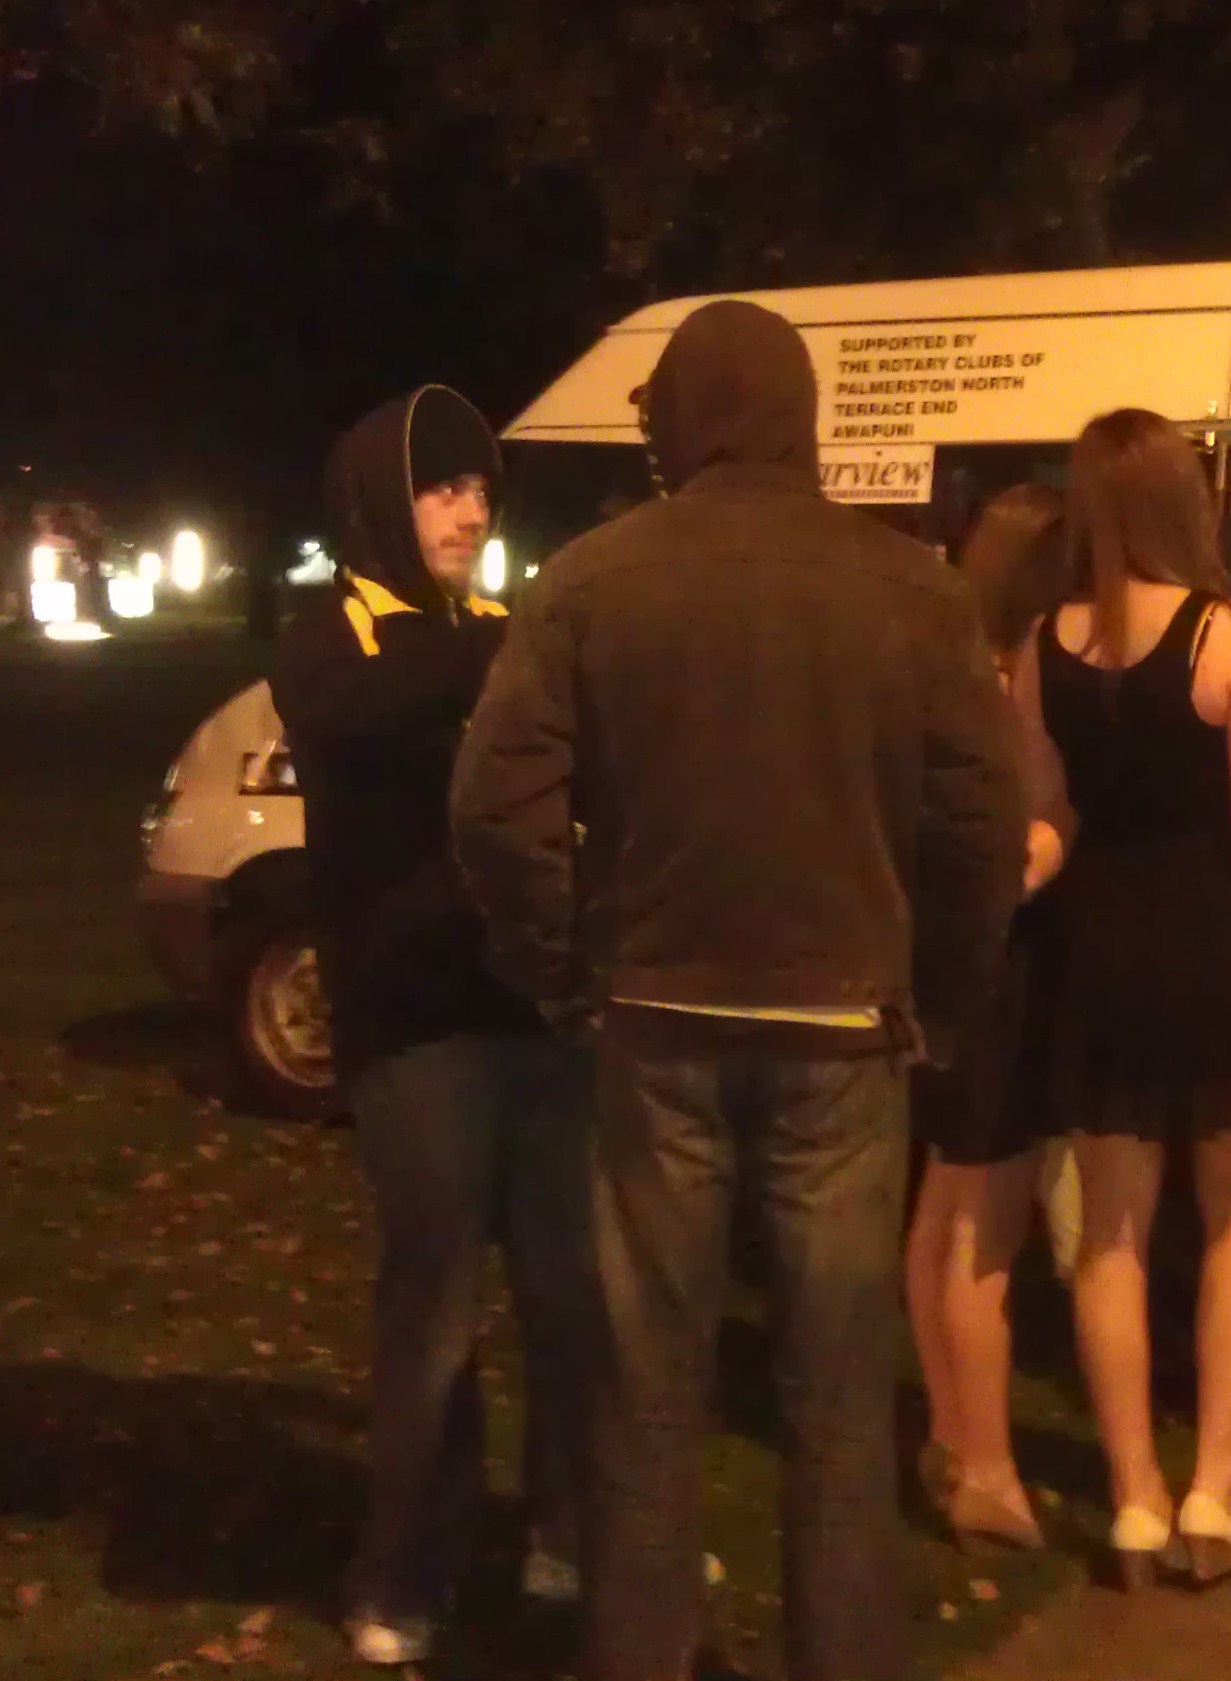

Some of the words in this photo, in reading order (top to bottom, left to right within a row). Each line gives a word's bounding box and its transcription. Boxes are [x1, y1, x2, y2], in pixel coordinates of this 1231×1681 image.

[839, 335, 947, 353] SUPPORTED
[953, 334, 977, 349] BY
[838, 359, 871, 375] THE
[878, 357, 949, 373] ROTARY
[954, 354, 1015, 371] CLUBS
[1021, 352, 1046, 368] OF
[836, 378, 956, 396] PALMERSTON
[962, 376, 1025, 392] NORTH
[834, 402, 916, 418] TERRACE
[921, 400, 958, 415] END
